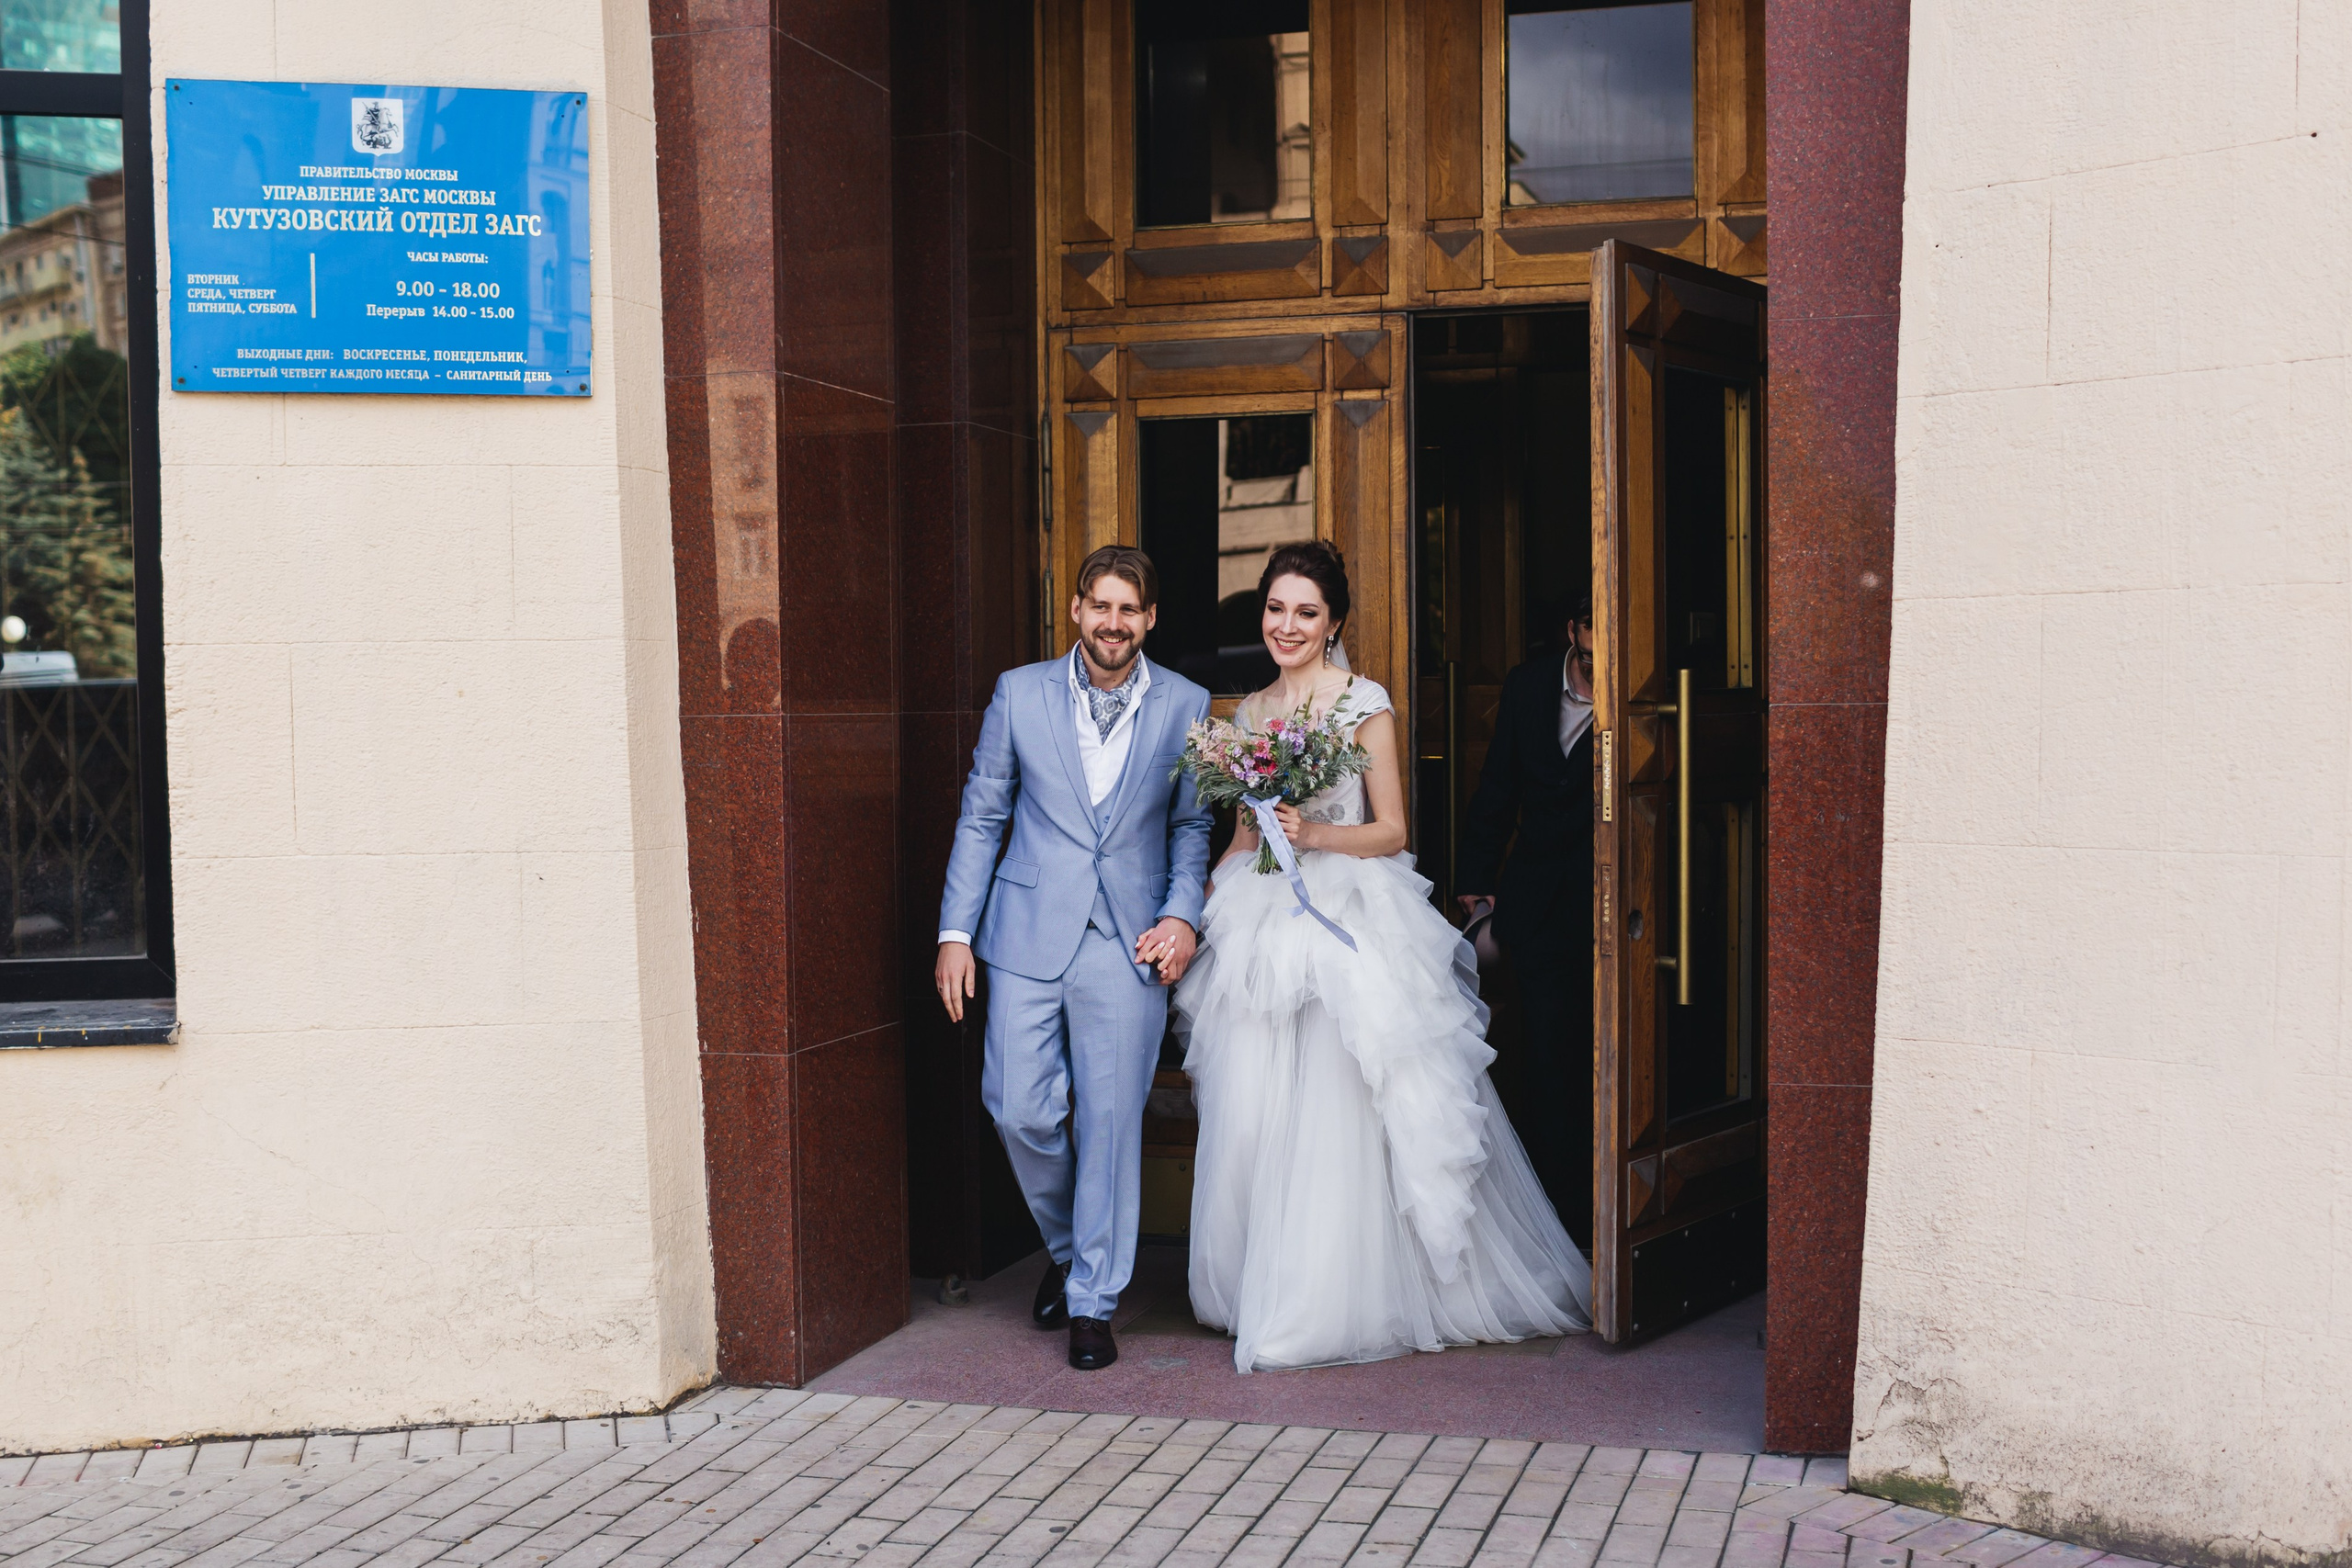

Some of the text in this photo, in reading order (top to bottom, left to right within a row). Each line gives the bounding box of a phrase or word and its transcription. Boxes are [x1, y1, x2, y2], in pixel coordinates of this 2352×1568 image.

[300, 166, 458, 181] ПРАВИТЕЛЬСТВО МОСКВЫ
[263, 186, 496, 206] УПРАВЛЕНИЕ ЗАГС МОСКВЫ
[212, 207, 541, 238] КУТУЗОВСКИЙ ОТДЕЛ ЗАГС
[407, 252, 488, 264] ЧАСЫ РАБОТЫ:
[187, 275, 239, 284] ВТОРНИК
[187, 288, 276, 300] СРЕДА, ЧЕТВЕРГ
[396, 281, 434, 297] 9.00
[452, 282, 500, 298] 18.00
[188, 302, 297, 314] ПЯТНИЦА, СУББОТА
[367, 304, 425, 319] Перерыв
[433, 306, 467, 318] 14.00
[481, 307, 514, 319] 15.00
[237, 349, 527, 364] ВЫХОДНЫЕ ДНИ: ВОСКРЕСЕНЬЕ, ПОНЕДЕЛЬНИК,
[212, 367, 277, 378] ЧЕТВЕРТЫЙ
[280, 368, 327, 378] ЧЕТВЕРГ
[330, 369, 382, 380] КАЖДОГО
[386, 369, 429, 381] МЕСЯЦА
[447, 369, 521, 381] САНИТАРНЫЙ
[524, 372, 552, 383] ДЕНЬ
